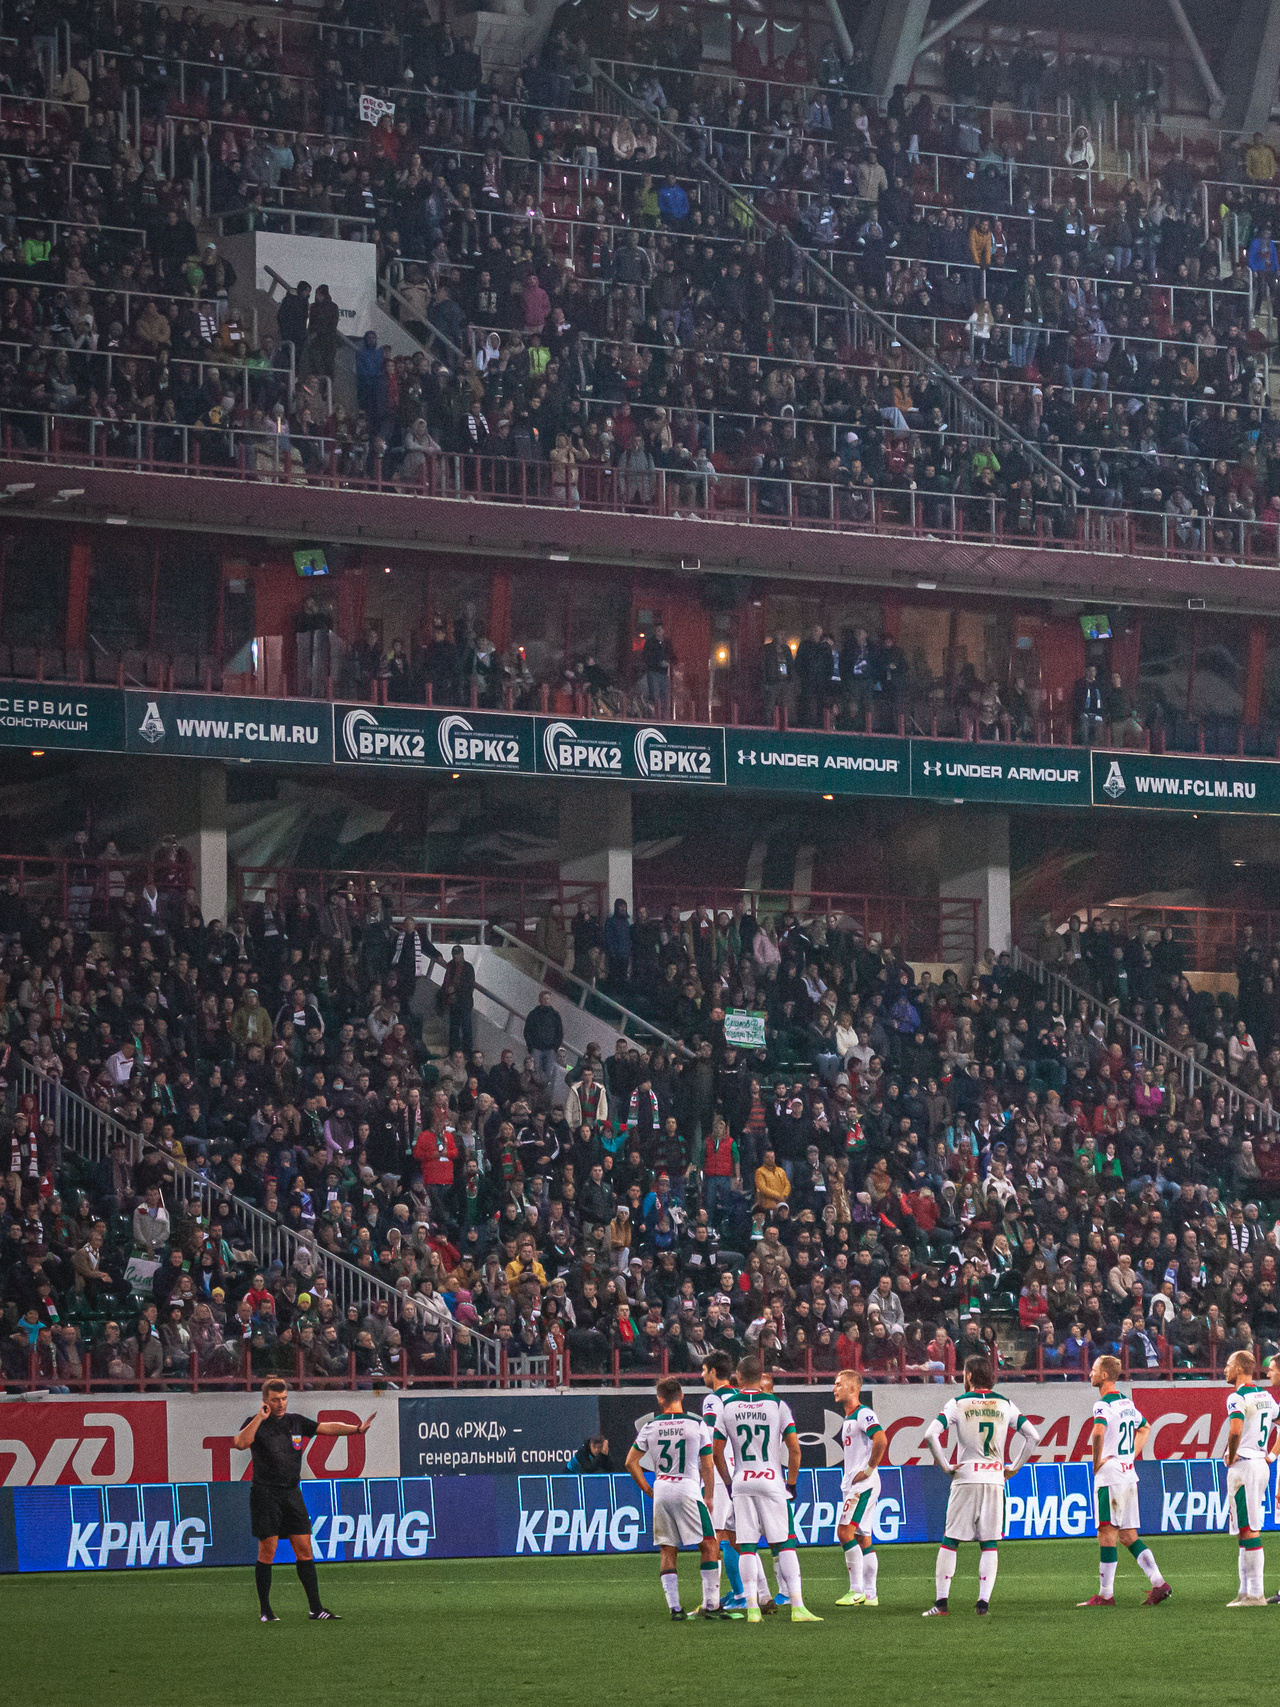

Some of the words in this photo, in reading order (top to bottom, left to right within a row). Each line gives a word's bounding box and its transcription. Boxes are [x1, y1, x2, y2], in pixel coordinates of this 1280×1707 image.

[176, 718, 319, 744] WWW.FCLM.RU
[760, 752, 819, 768] UNDER
[823, 755, 899, 773] ARMOUR
[946, 763, 1002, 779] UNDER
[1007, 766, 1080, 783] ARMOUR
[1134, 776, 1256, 799] WWW.FCLM.RU
[418, 1421, 450, 1439] ОАО
[455, 1421, 506, 1441] «РЖД»
[658, 1428, 684, 1437] РЫБУС
[734, 1411, 767, 1422] МУРИЛО
[1257, 1412, 1268, 1447] 5
[736, 1423, 770, 1462] 27
[979, 1422, 994, 1456] 7
[1118, 1420, 1135, 1455] 20
[419, 1447, 517, 1468] генеральный
[657, 1439, 686, 1474] 31
[790, 1497, 901, 1544] KPG
[1004, 1492, 1088, 1537] PMG
[1160, 1490, 1266, 1532] KPM
[67, 1517, 206, 1568] KPMG
[311, 1510, 430, 1561] KPMG
[515, 1505, 641, 1553] KPMG
